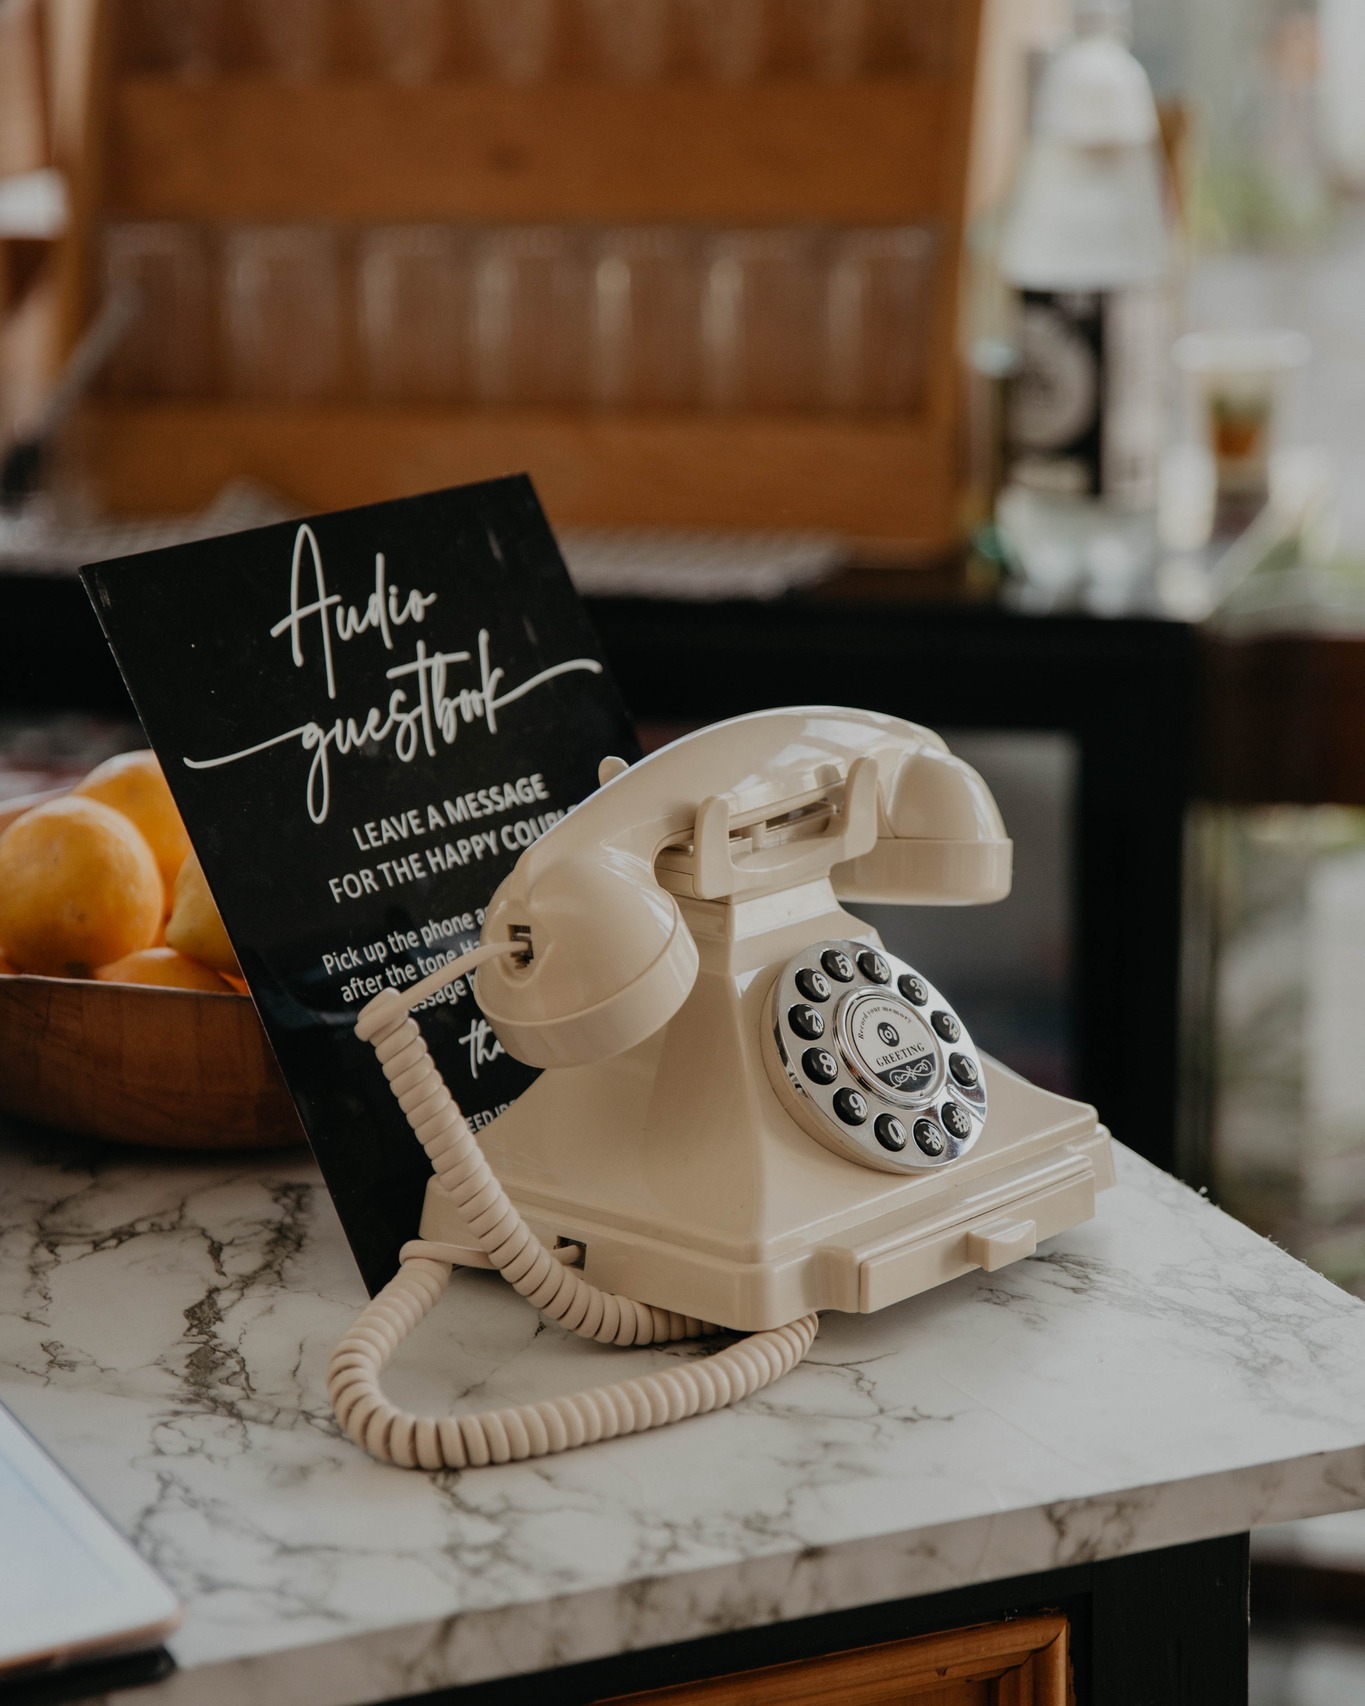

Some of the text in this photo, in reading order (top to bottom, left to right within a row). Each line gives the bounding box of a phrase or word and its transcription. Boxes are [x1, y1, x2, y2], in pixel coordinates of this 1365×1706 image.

[270, 523, 438, 699] Audio
[183, 629, 603, 824] guestbook
[353, 773, 550, 851] LEAVE A MESSAGE
[328, 804, 577, 903] FOR THE HAPPY COUP
[322, 946, 363, 975] Pick
[363, 941, 388, 964] up
[387, 930, 421, 953] the
[420, 912, 476, 948] phone
[340, 974, 383, 1003] after
[385, 963, 418, 988] the
[416, 949, 458, 976] tone
[834, 954, 853, 978] 5
[874, 954, 890, 980] 4
[812, 973, 831, 997] 6
[909, 978, 927, 1001] 3
[805, 1008, 823, 1033] 7
[942, 1014, 960, 1040] 2
[818, 1053, 837, 1077] 8
[875, 1042, 925, 1067] GREETING
[959, 1058, 977, 1080] 1
[849, 1094, 868, 1117] 9
[887, 1120, 906, 1144] 0
